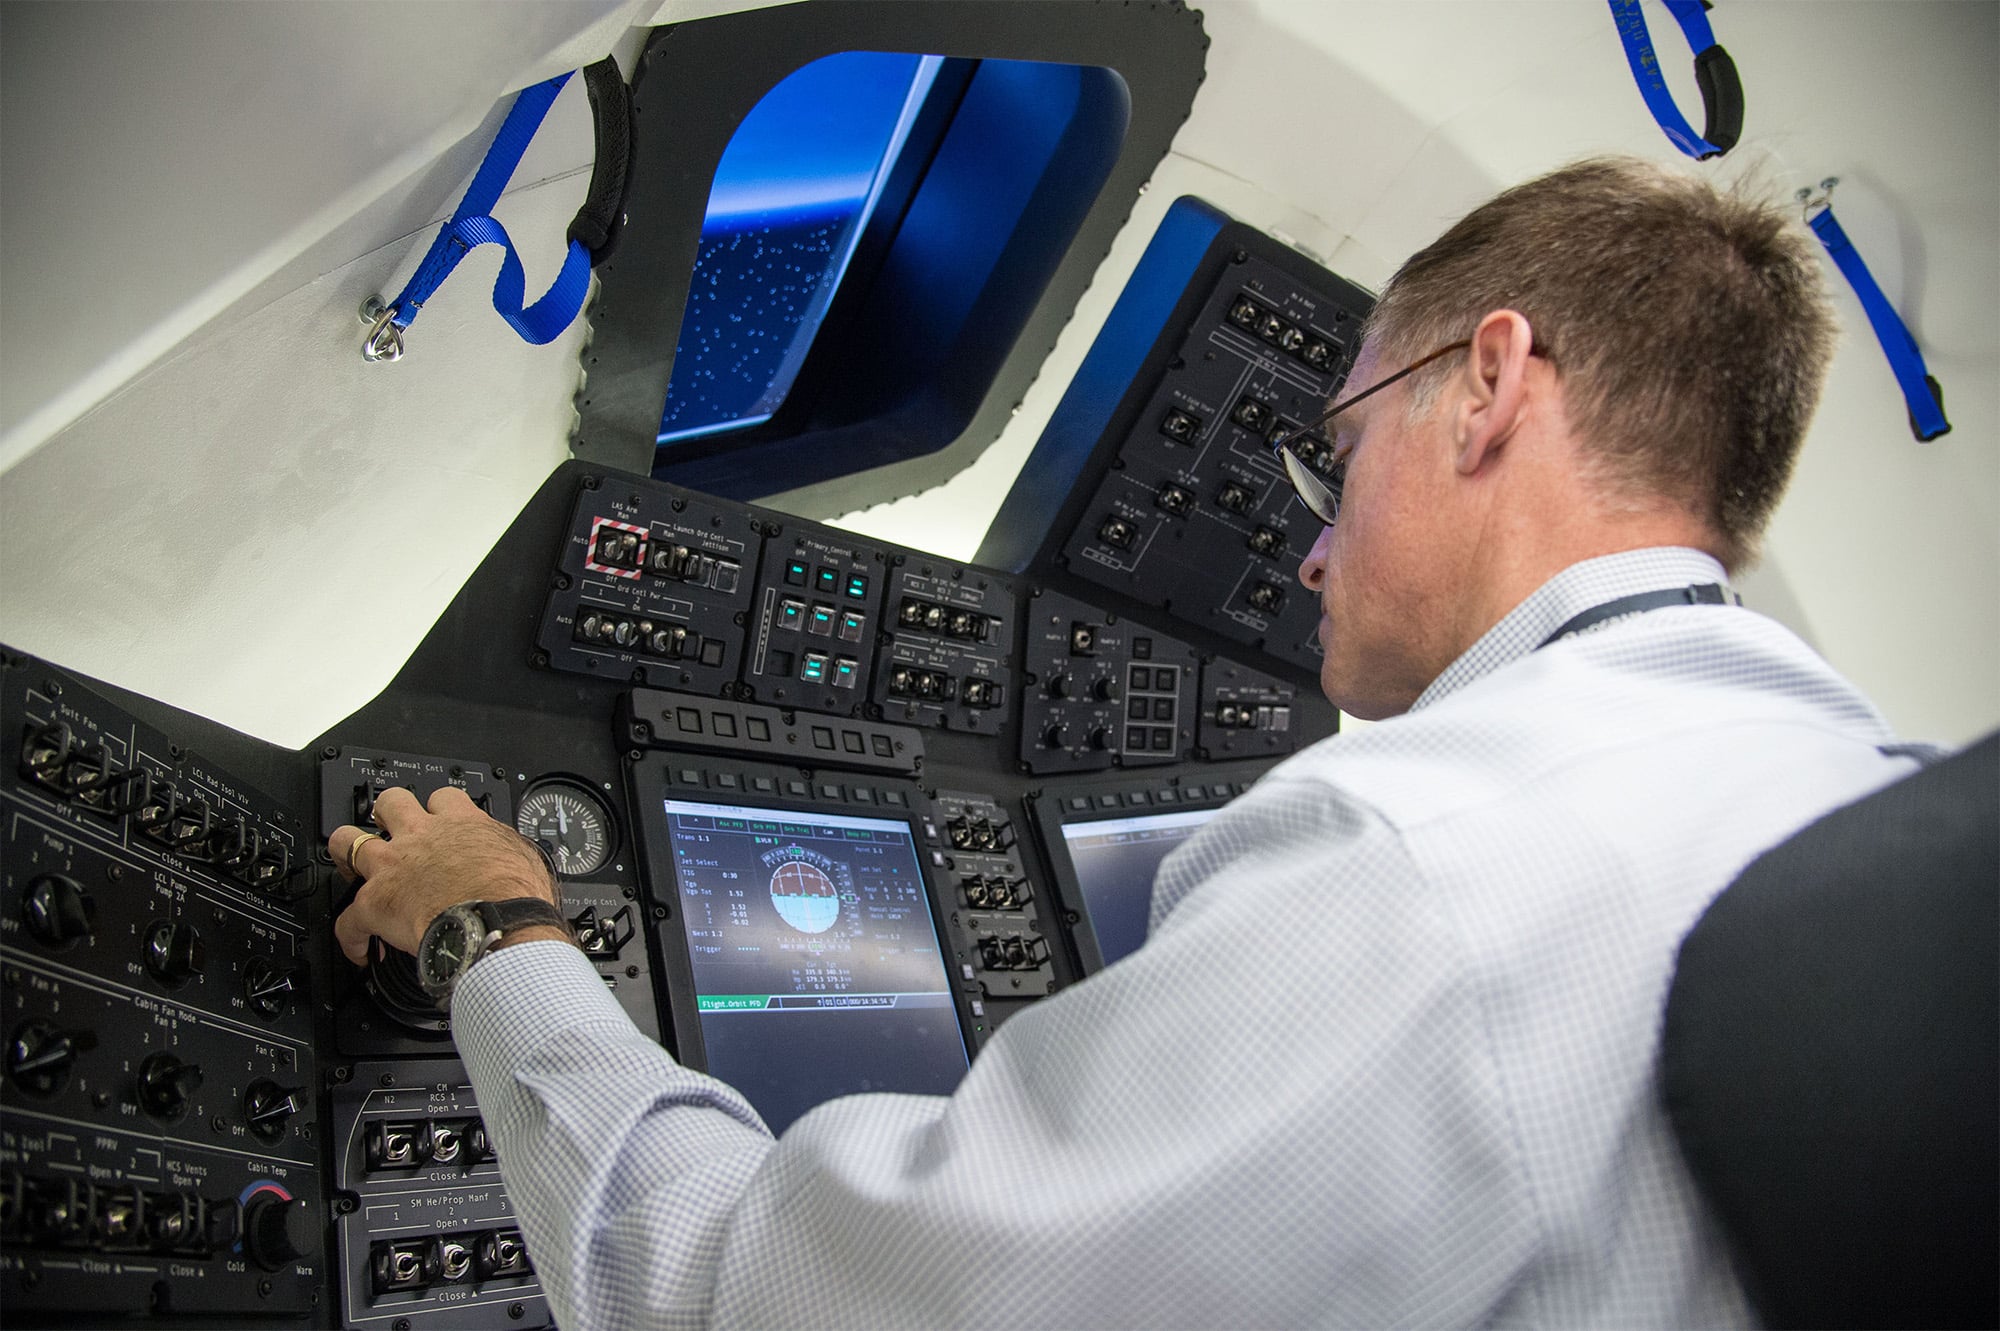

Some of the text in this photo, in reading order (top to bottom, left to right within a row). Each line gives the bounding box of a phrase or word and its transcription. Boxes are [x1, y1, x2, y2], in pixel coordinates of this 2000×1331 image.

[611, 502, 639, 514] LAS Arm
[617, 512, 630, 520] Man
[663, 530, 675, 538] Man
[673, 523, 725, 542] Launch Ord Cntl
[572, 535, 588, 545] Auto
[702, 540, 729, 552] Jettison
[807, 540, 829, 552] Primary
[830, 546, 852, 557] Control
[606, 575, 619, 584] Off
[654, 580, 667, 589] Off
[617, 583, 661, 600] Ord Cntl Pwr
[633, 604, 641, 612] On
[556, 615, 573, 625] Auto
[620, 654, 634, 663] Off
[50, 710, 57, 720] A
[60, 703, 98, 732] Suit Fan
[99, 736, 105, 746] B
[393, 760, 444, 773] Manual Cntl
[155, 767, 164, 778] In
[178, 769, 183, 779] 1
[361, 768, 399, 779] Flt Cntl
[192, 767, 250, 805] LCL Rad Isol Vlv
[375, 776, 386, 785] On
[448, 777, 466, 787] Baro
[193, 788, 207, 801] Out
[57, 804, 73, 818] Off
[237, 812, 246, 823] In
[256, 814, 262, 823] 2
[532, 818, 538, 826] 8
[581, 821, 588, 829] 2
[270, 830, 282, 843] Out
[43, 834, 74, 856] Pump 1
[585, 842, 591, 851] 3
[32, 852, 39, 864] 2
[161, 854, 184, 870] Close
[696, 859, 719, 868] Select
[65, 860, 71, 871] 3
[154, 871, 188, 893] LCL Pump
[155, 883, 186, 904] Pump 2A
[149, 900, 155, 910] 2
[245, 892, 267, 908] Close
[563, 898, 580, 906] ntry
[600, 898, 617, 906] Cntl
[176, 906, 182, 916] 3
[1, 918, 20, 933] Off
[131, 924, 136, 934] 1
[251, 923, 277, 940] Pump 2B
[89, 936, 96, 947] 5
[246, 940, 252, 949] 2
[269, 944, 275, 953] 3
[128, 962, 143, 975] Off
[232, 962, 237, 971] 1
[199, 974, 205, 984] 5
[31, 976, 60, 994] Fan A
[53, 1000, 60, 1013] 3
[231, 997, 244, 1009] Off
[134, 996, 197, 1024] Cabin Fan Mode
[290, 1005, 296, 1015] 5
[154, 1015, 178, 1029] Fan B
[144, 1033, 150, 1043] 2
[173, 1036, 178, 1046] 3
[255, 1044, 276, 1057] Fan C
[124, 1061, 130, 1071] 1
[247, 1061, 253, 1071] 2
[271, 1063, 276, 1072] 3
[232, 1087, 237, 1097] 1
[436, 1083, 448, 1092] CM
[385, 1096, 396, 1105] N2
[430, 1093, 456, 1102] RCS 1
[121, 1103, 137, 1116] Off
[198, 1105, 203, 1115] 5
[428, 1104, 449, 1114] Open
[232, 1126, 245, 1137] Off
[295, 1127, 300, 1136] 5
[76, 1149, 82, 1161] 1
[130, 1157, 137, 1169] 2
[89, 1165, 112, 1181] Open
[185, 1163, 208, 1177] Vents
[247, 1161, 288, 1178] Cabin Temp
[173, 1175, 194, 1188] Open
[430, 1171, 457, 1182] Close
[411, 1193, 490, 1207] SM He/Prop Manf
[449, 1207, 455, 1216] 2
[501, 1202, 507, 1211] 3
[394, 1212, 400, 1221] 1
[436, 1219, 458, 1229] Open
[81, 1257, 111, 1274] Close
[170, 1263, 196, 1277] Close
[227, 1260, 246, 1273] Cold
[296, 1265, 313, 1277] Warm
[439, 1291, 467, 1302] Close
